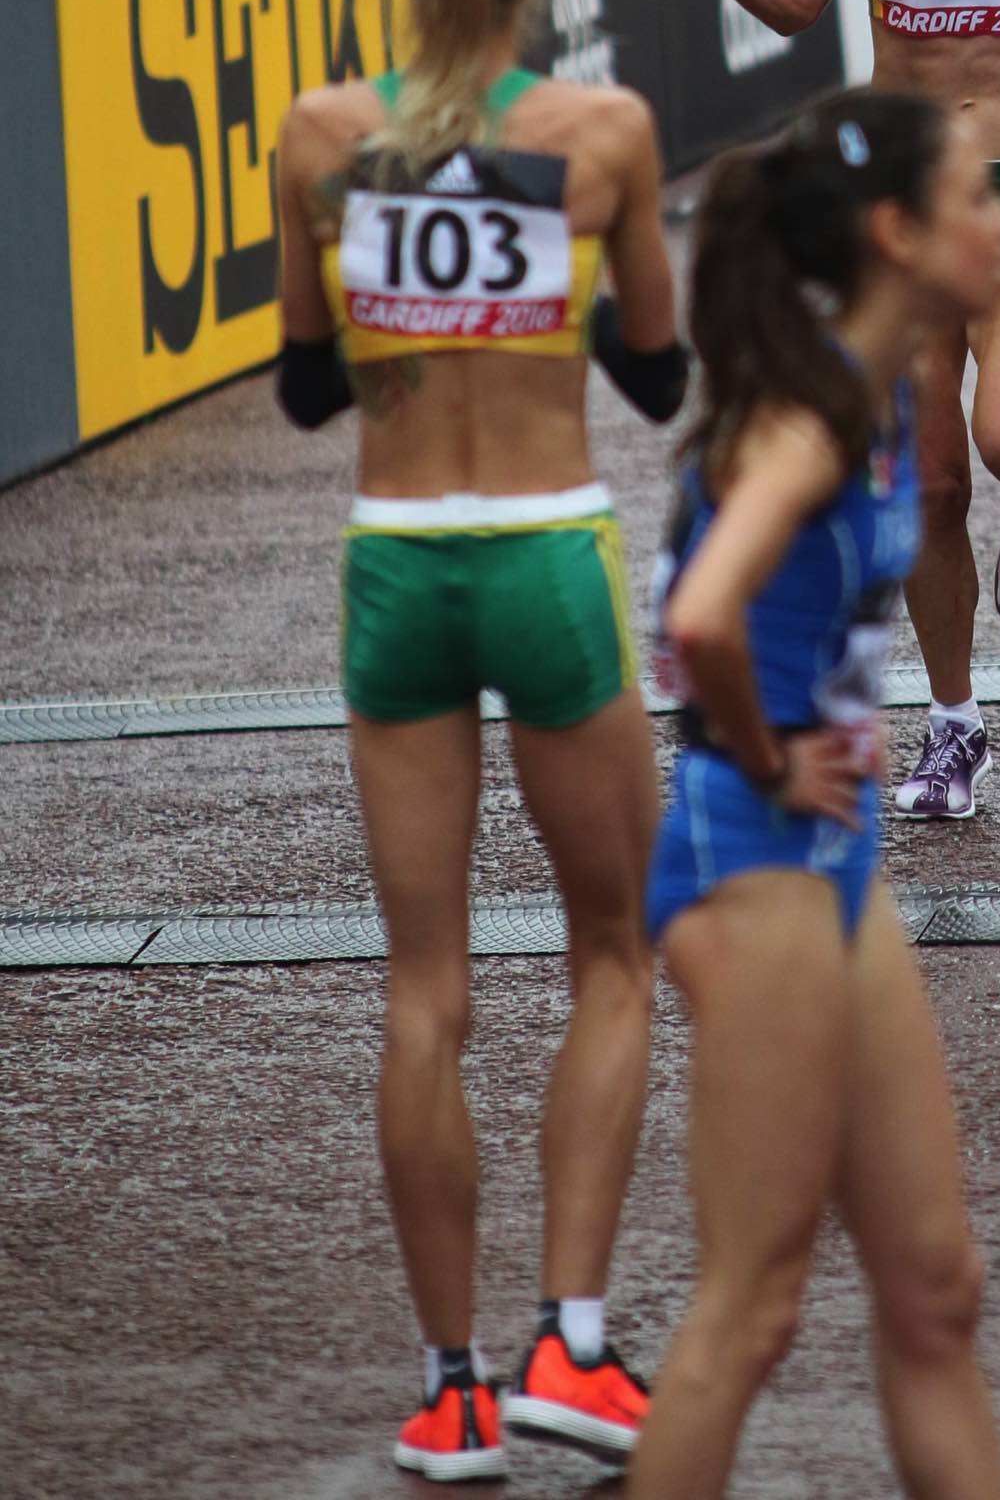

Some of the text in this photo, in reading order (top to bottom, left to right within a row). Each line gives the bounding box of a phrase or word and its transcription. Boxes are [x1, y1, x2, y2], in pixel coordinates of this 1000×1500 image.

[887, 4, 988, 33] CARDIFF
[378, 205, 529, 292] 103
[351, 297, 555, 334] CARDIFF 2016
